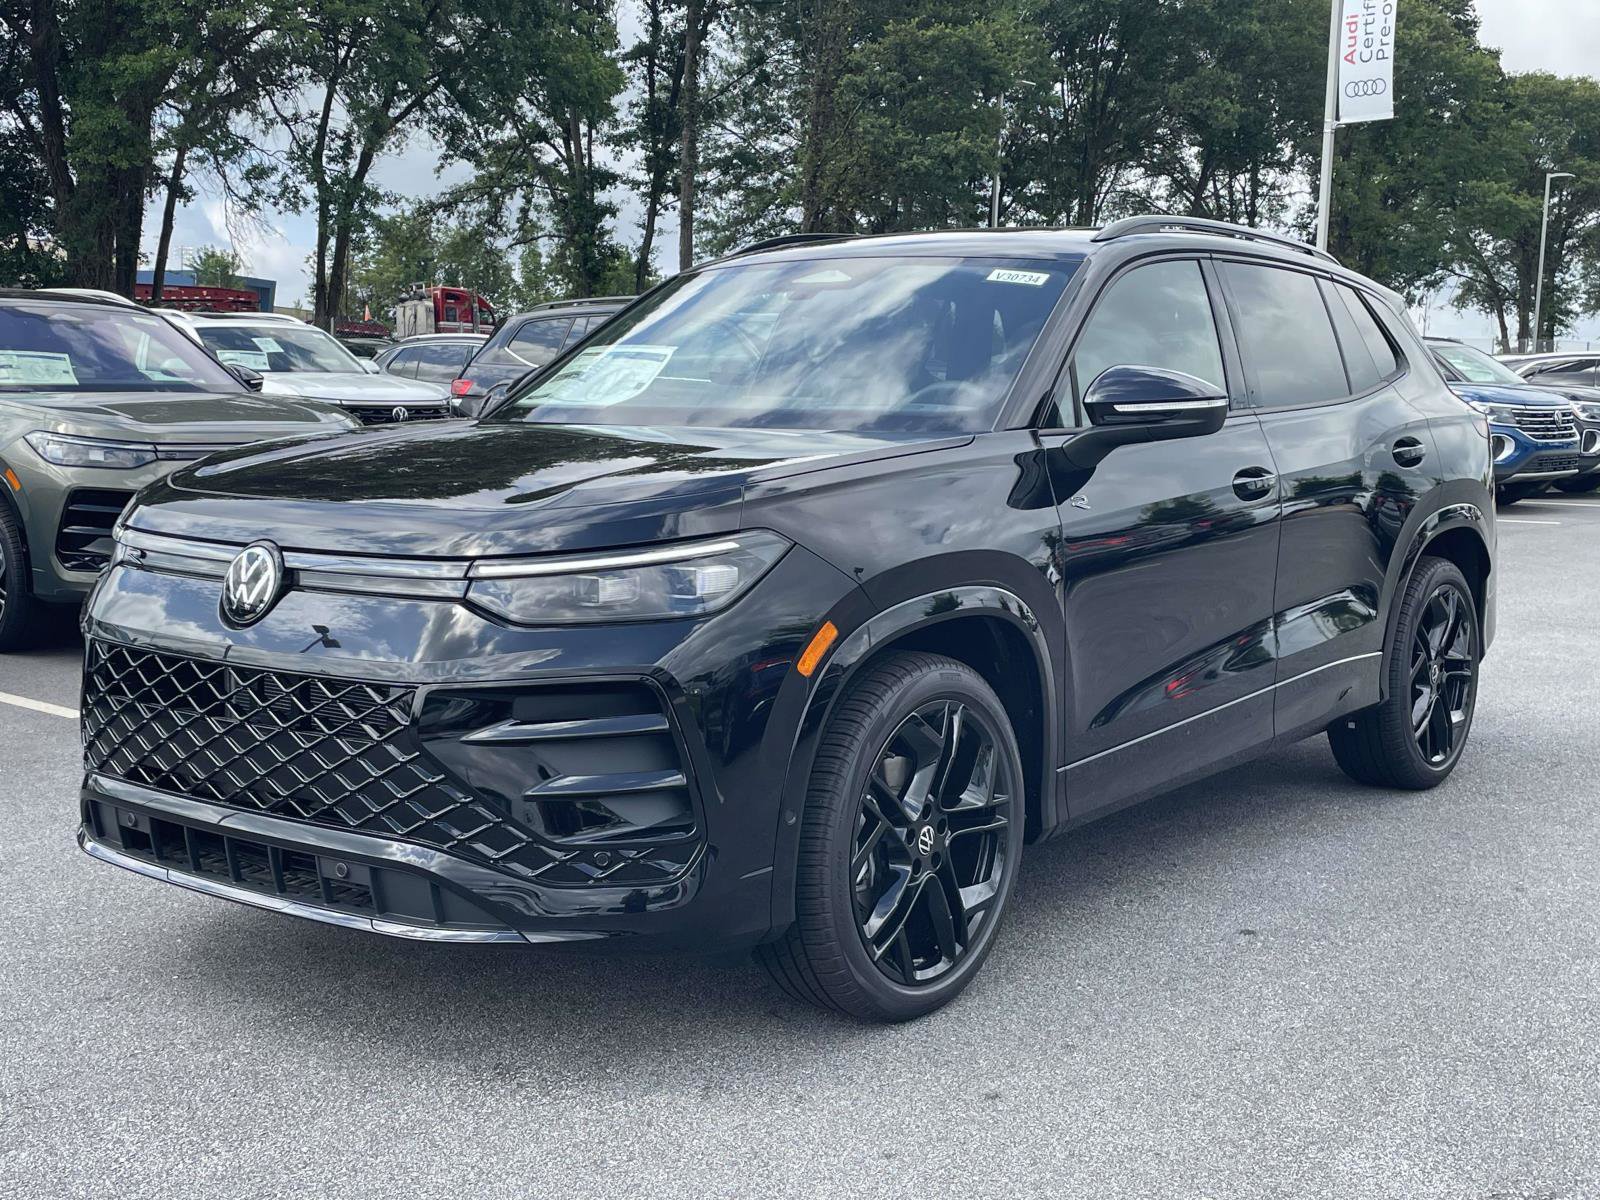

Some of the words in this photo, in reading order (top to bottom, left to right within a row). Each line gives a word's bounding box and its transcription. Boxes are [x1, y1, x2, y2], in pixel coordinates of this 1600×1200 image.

[1344, 14, 1359, 65] Audi
[1376, 0, 1393, 61] Pre-o
[996, 271, 1041, 284] V30734
[224, 546, 276, 622] VW
